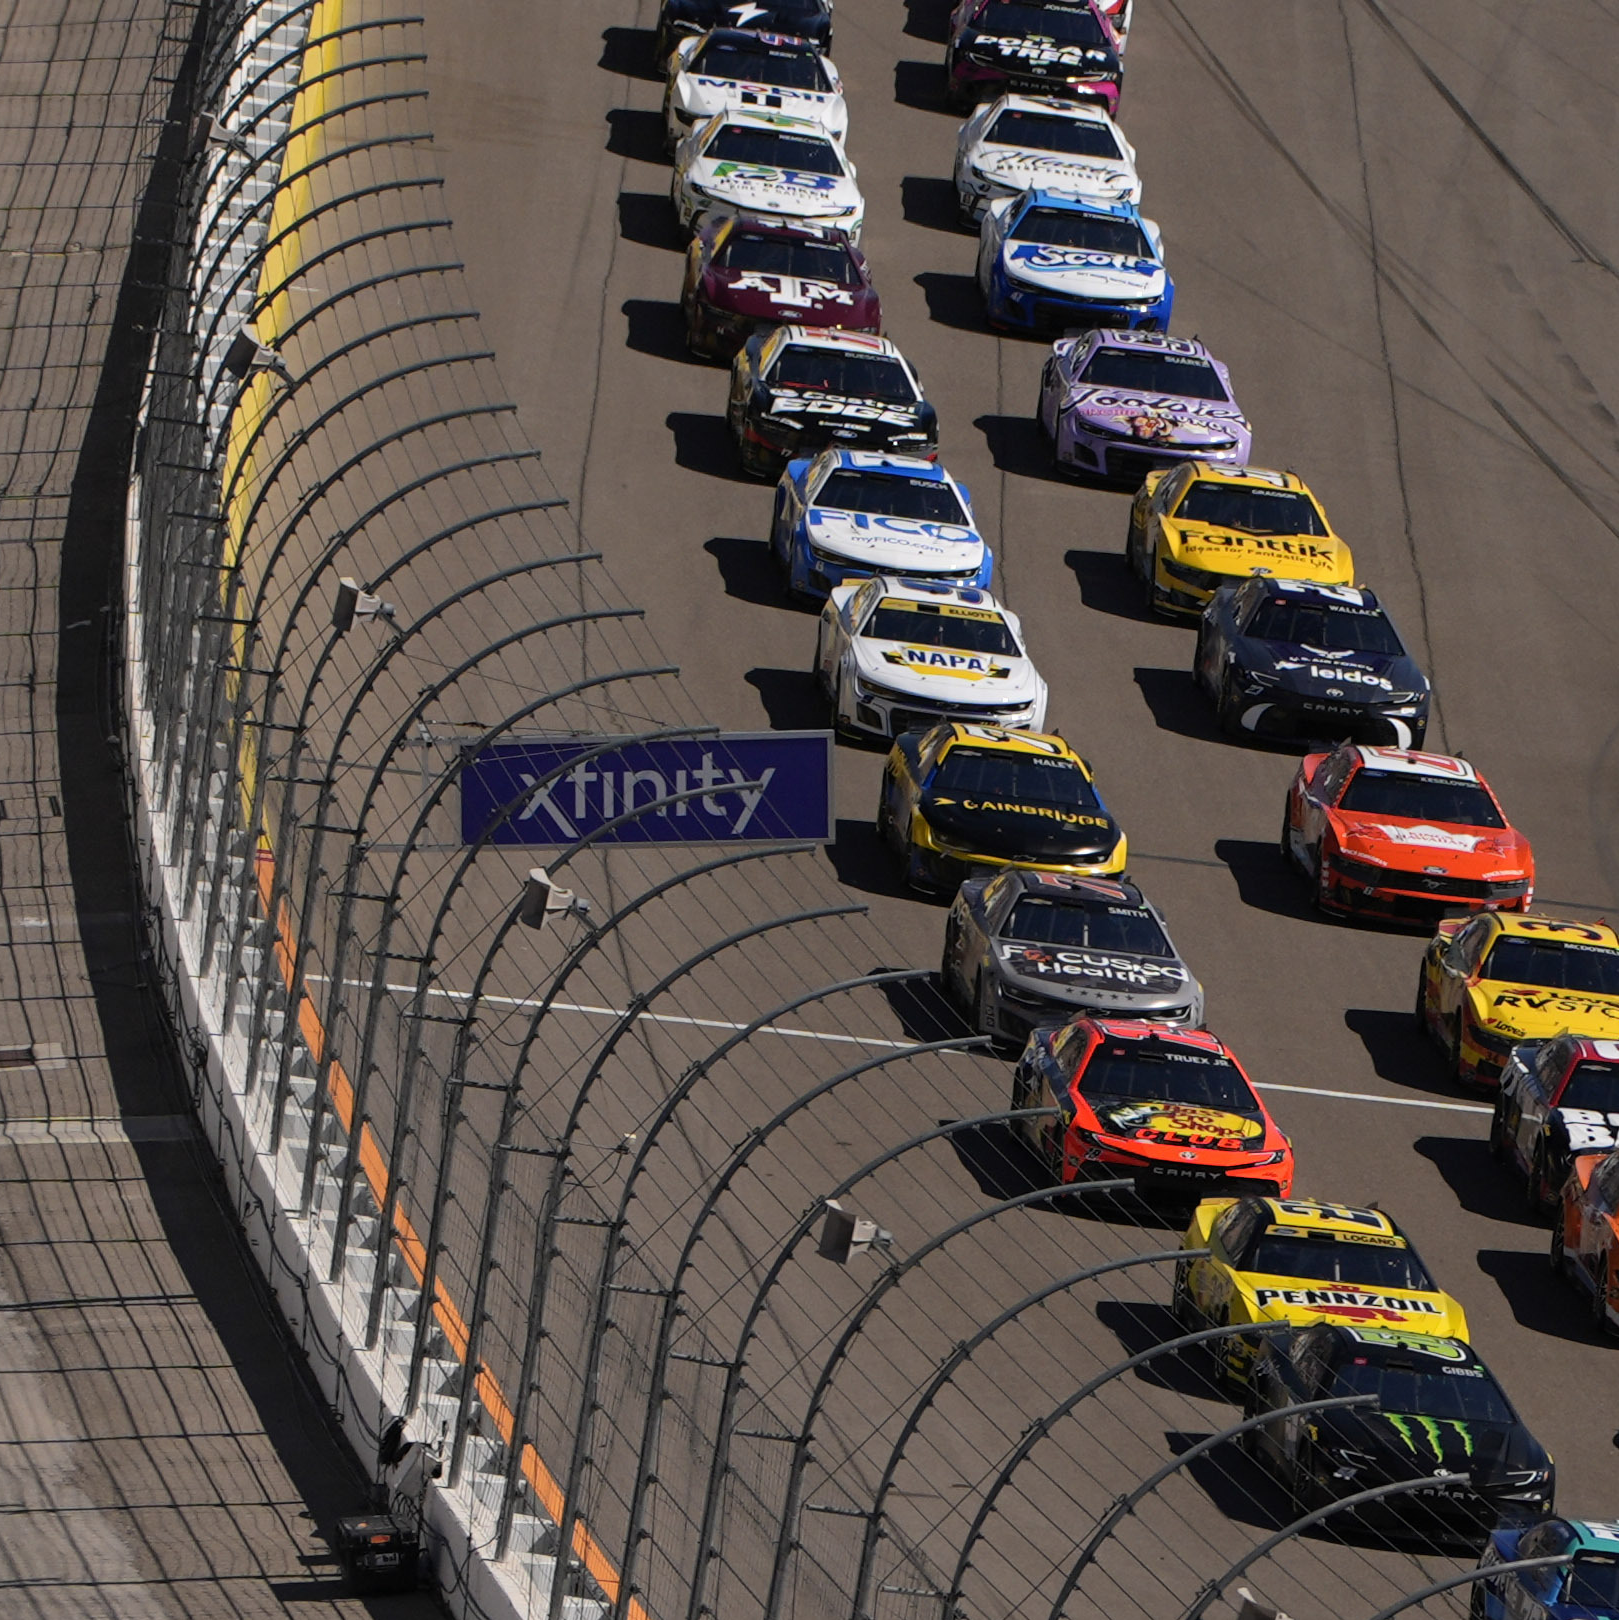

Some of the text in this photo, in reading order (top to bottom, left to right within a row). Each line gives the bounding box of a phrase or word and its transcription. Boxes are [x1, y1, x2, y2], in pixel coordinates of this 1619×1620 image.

[974, 34, 1107, 61] DOLLAR
[998, 45, 1082, 66] TREE
[698, 78, 825, 103] Mobil
[771, 396, 920, 427] EDGE
[802, 390, 916, 414] Castrol
[910, 478, 948, 491] BUSCH
[809, 509, 981, 544] FICO
[851, 534, 944, 554] myFICO.com
[1179, 529, 1335, 564] Fanttik
[948, 607, 993, 621] ELLIOTT
[1328, 604, 1379, 618] WALLACE
[905, 650, 986, 672] NAPA
[1310, 665, 1394, 691] leidos
[1302, 702, 1364, 715] CAMRY
[1033, 756, 1072, 770] HALEY
[518, 751, 776, 838] xfinity
[962, 800, 1109, 830] GAINBRIDGE
[1107, 906, 1149, 919] SMITH
[1037, 961, 1148, 986] Health
[1165, 1052, 1210, 1066] TRUEX
[1163, 1103, 1225, 1119] Bass
[1135, 1128, 1243, 1150] CLUB
[1168, 1117, 1247, 1139] Shops
[1153, 1166, 1223, 1180] CAMRY
[1342, 1233, 1397, 1248] LOGANO
[1255, 1289, 1445, 1316] PENNZOIL
[1442, 1365, 1484, 1379] GIBBS
